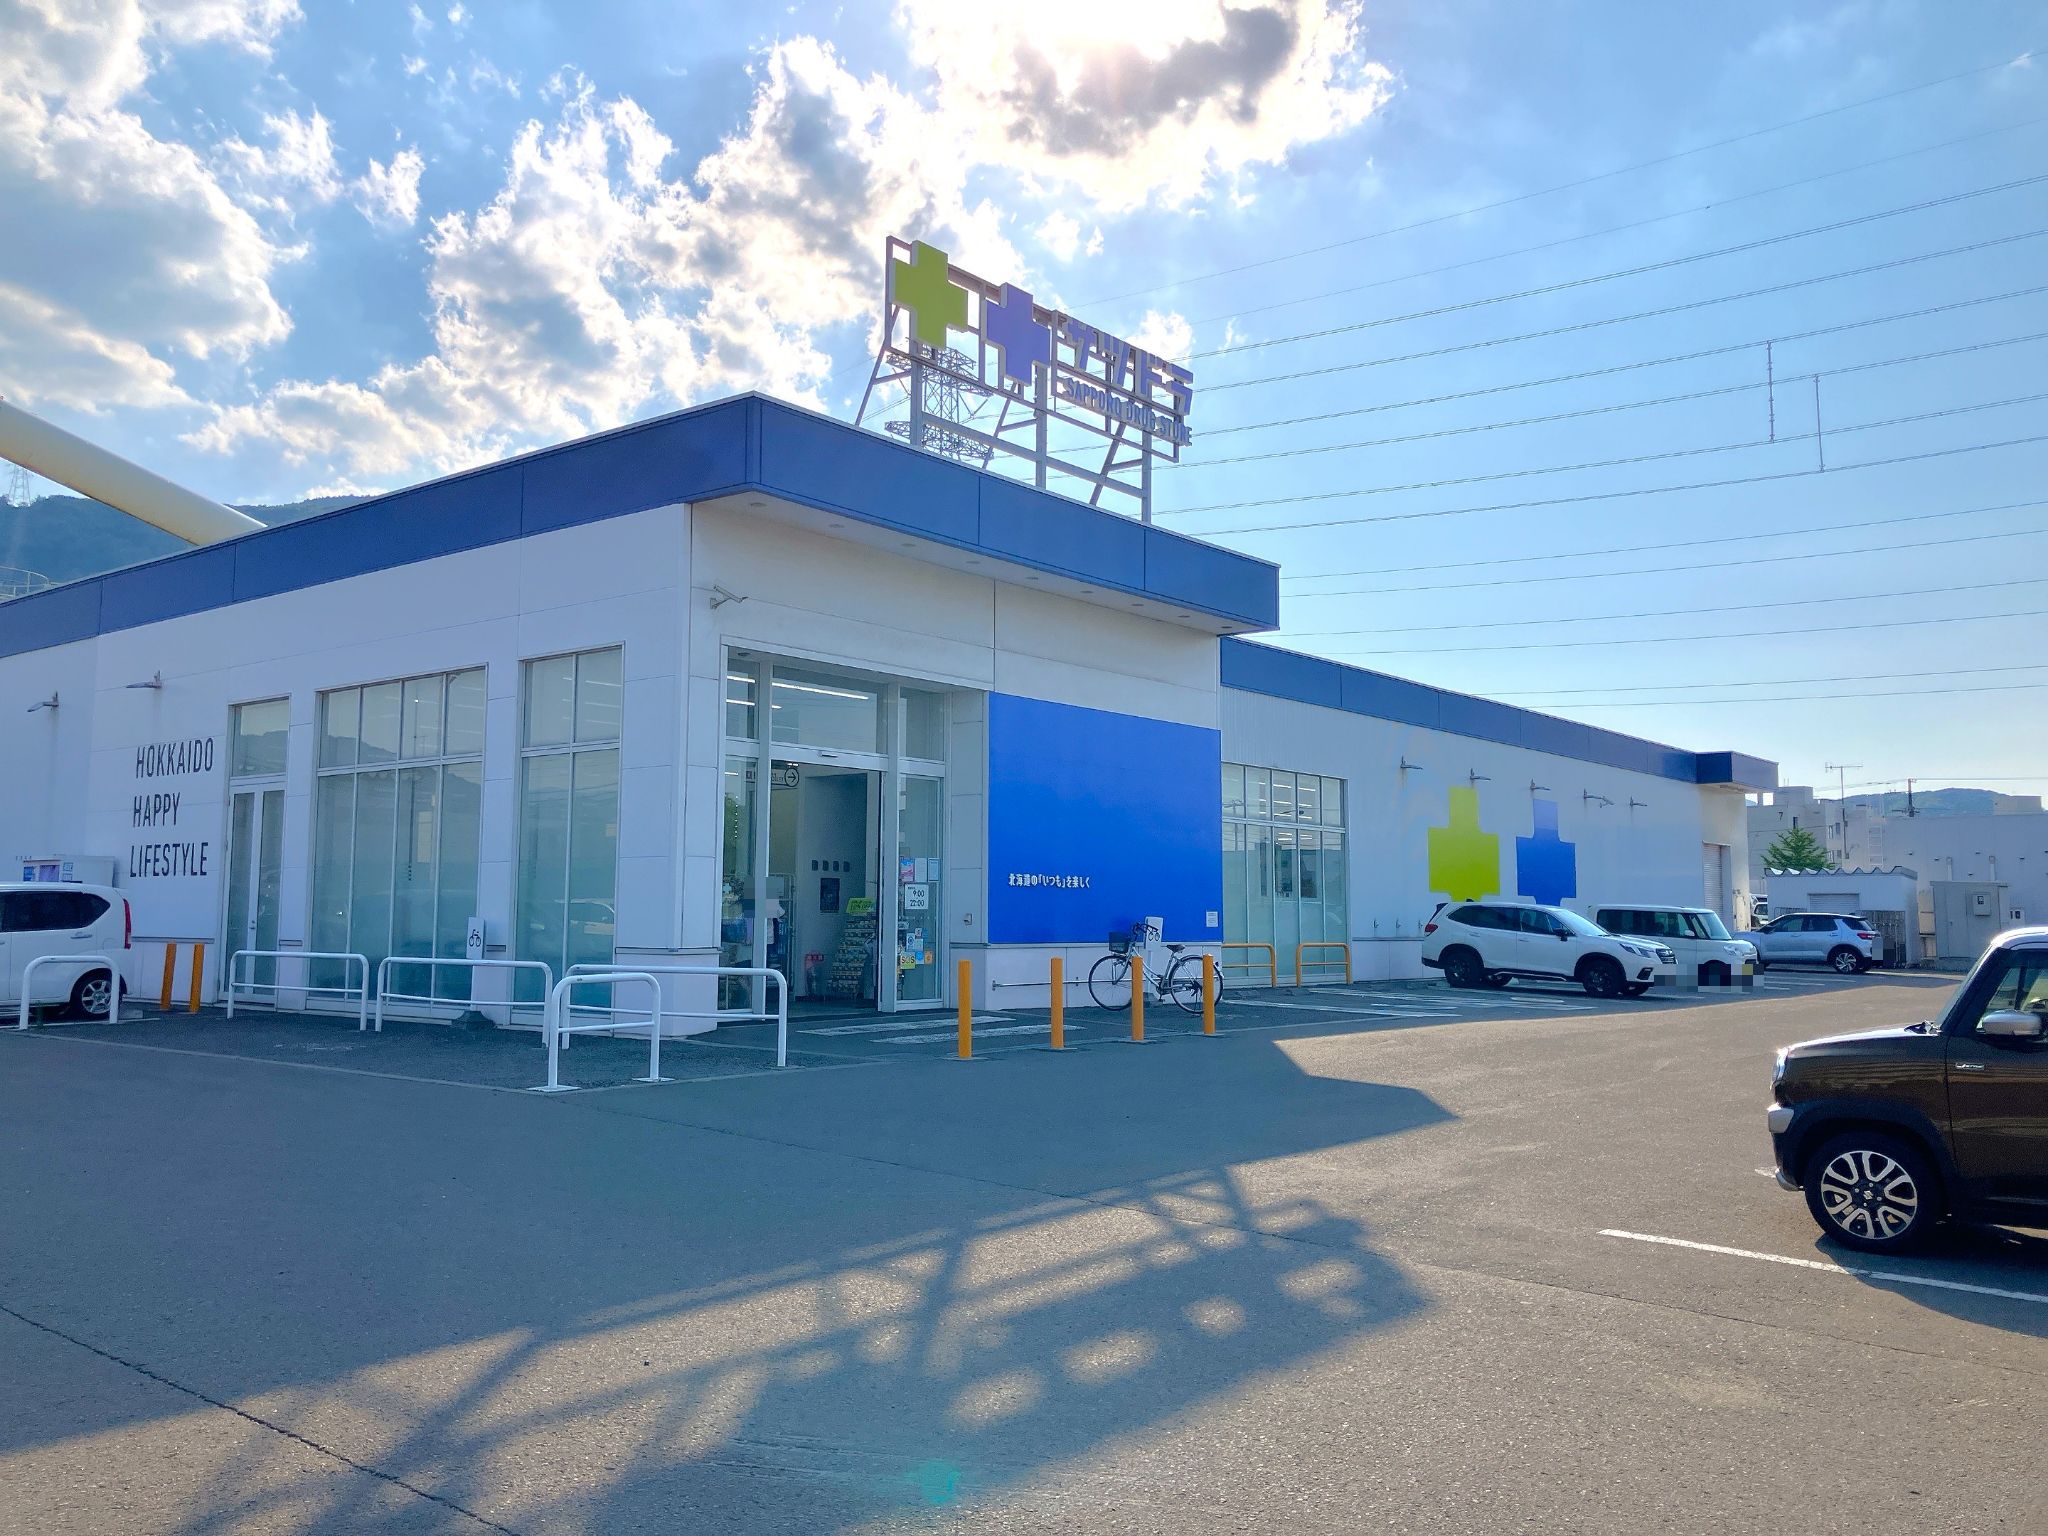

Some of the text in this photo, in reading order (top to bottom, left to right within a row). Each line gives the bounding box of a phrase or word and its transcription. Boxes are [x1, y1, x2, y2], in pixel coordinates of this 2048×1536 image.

[1064, 317, 1193, 415] サツドラ
[1066, 377, 1122, 416] SAPPORO
[136, 737, 214, 778] HOKKAIDO
[133, 792, 180, 827] HAPPY
[130, 841, 208, 878] LIFESTYLE
